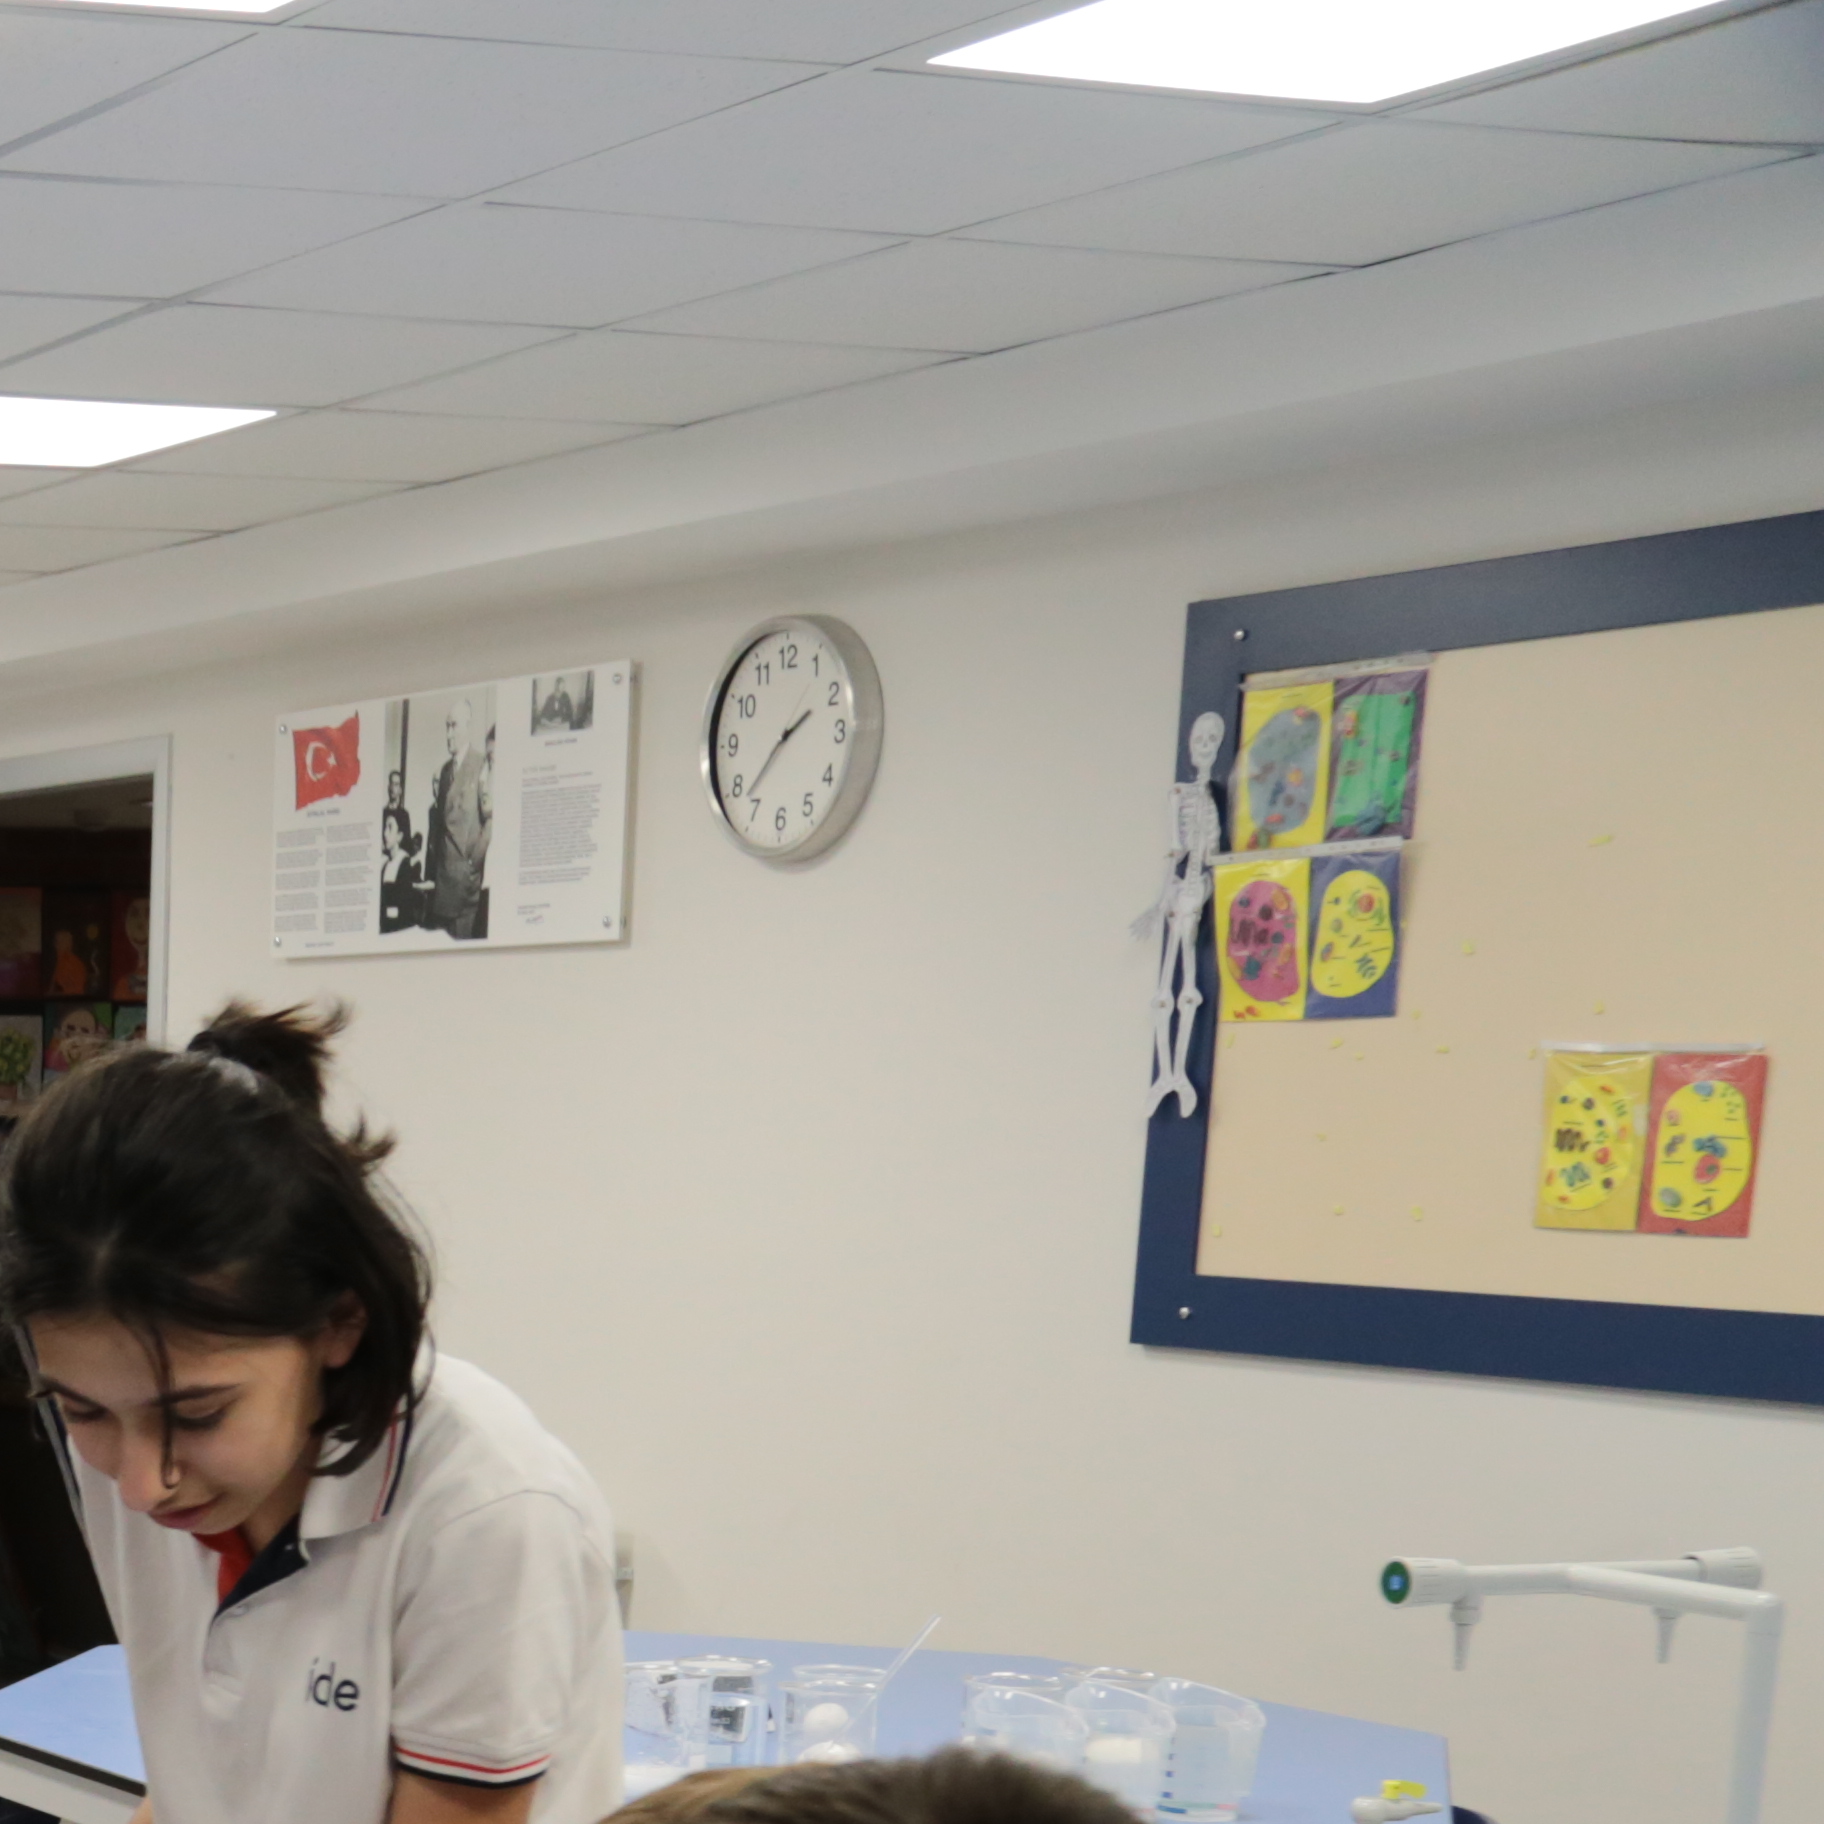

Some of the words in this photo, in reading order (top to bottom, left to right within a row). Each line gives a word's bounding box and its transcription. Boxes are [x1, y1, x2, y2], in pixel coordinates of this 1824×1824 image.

[779, 644, 798, 670] 12
[812, 653, 820, 677] 1
[755, 662, 770, 686] 11
[828, 682, 840, 706] 2
[738, 694, 756, 719] 10
[834, 719, 846, 744] 3
[728, 734, 739, 757] 9
[732, 774, 743, 798] 8
[822, 763, 834, 787] 4
[749, 799, 761, 822] 7
[802, 793, 814, 817] 5
[775, 807, 786, 831] 6
[305, 1657, 360, 1711] ide
